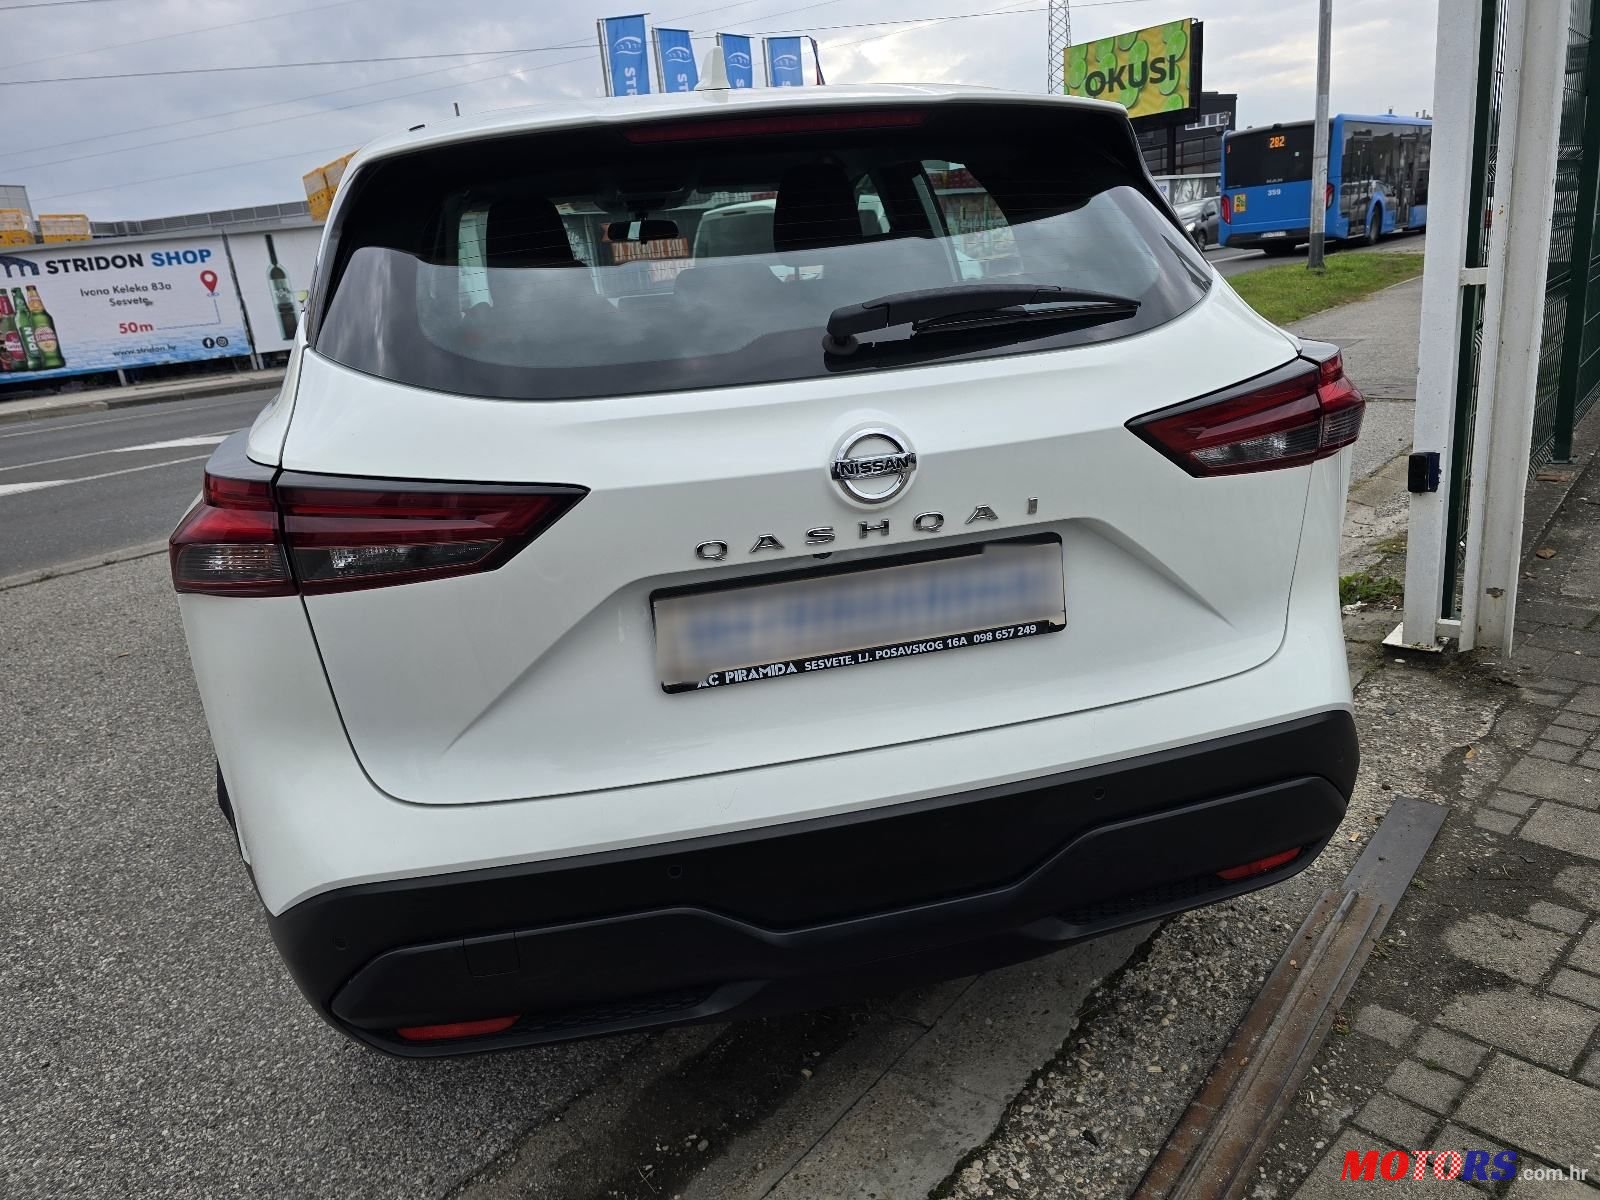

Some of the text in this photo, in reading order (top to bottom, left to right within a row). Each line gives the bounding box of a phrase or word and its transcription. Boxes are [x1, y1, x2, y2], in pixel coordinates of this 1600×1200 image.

[1085, 55, 1175, 96] OKUSI
[1269, 135, 1285, 148] 282
[45, 249, 212, 275] STRIDON SHOP
[112, 283, 149, 294] Keleka
[151, 282, 172, 291] 83a
[109, 296, 150, 307] Sesvete
[23, 326, 39, 352] PAN
[119, 321, 154, 335] 50m
[840, 457, 910, 477] NISSAN
[695, 496, 1039, 562] QASHQAI
[725, 662, 798, 684] PIRAMIDA
[804, 654, 856, 672] SESVETE,
[875, 640, 944, 660] POSAVSKOG
[946, 636, 968, 648] 16A
[973, 632, 993, 644] 098
[995, 628, 1015, 640] 657
[1017, 624, 1037, 637] 249
